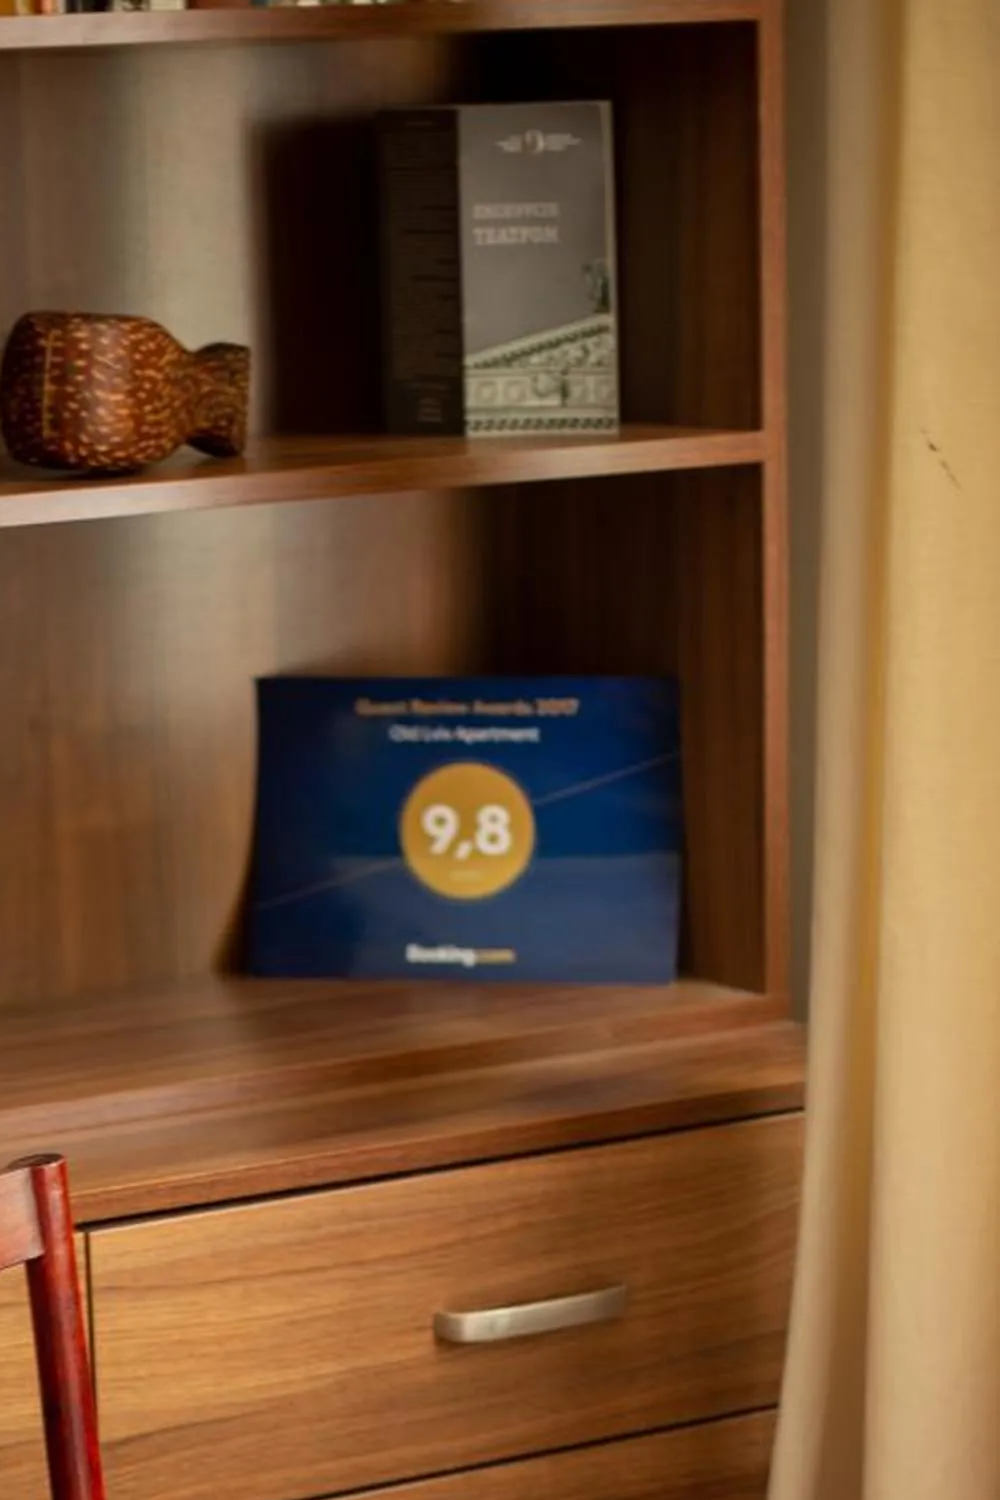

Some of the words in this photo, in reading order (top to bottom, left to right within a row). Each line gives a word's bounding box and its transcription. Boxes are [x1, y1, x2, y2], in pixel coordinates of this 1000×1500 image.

[455, 725, 540, 745] Apartment
[421, 804, 512, 860] 9,8
[405, 943, 517, 968] Booking.com
